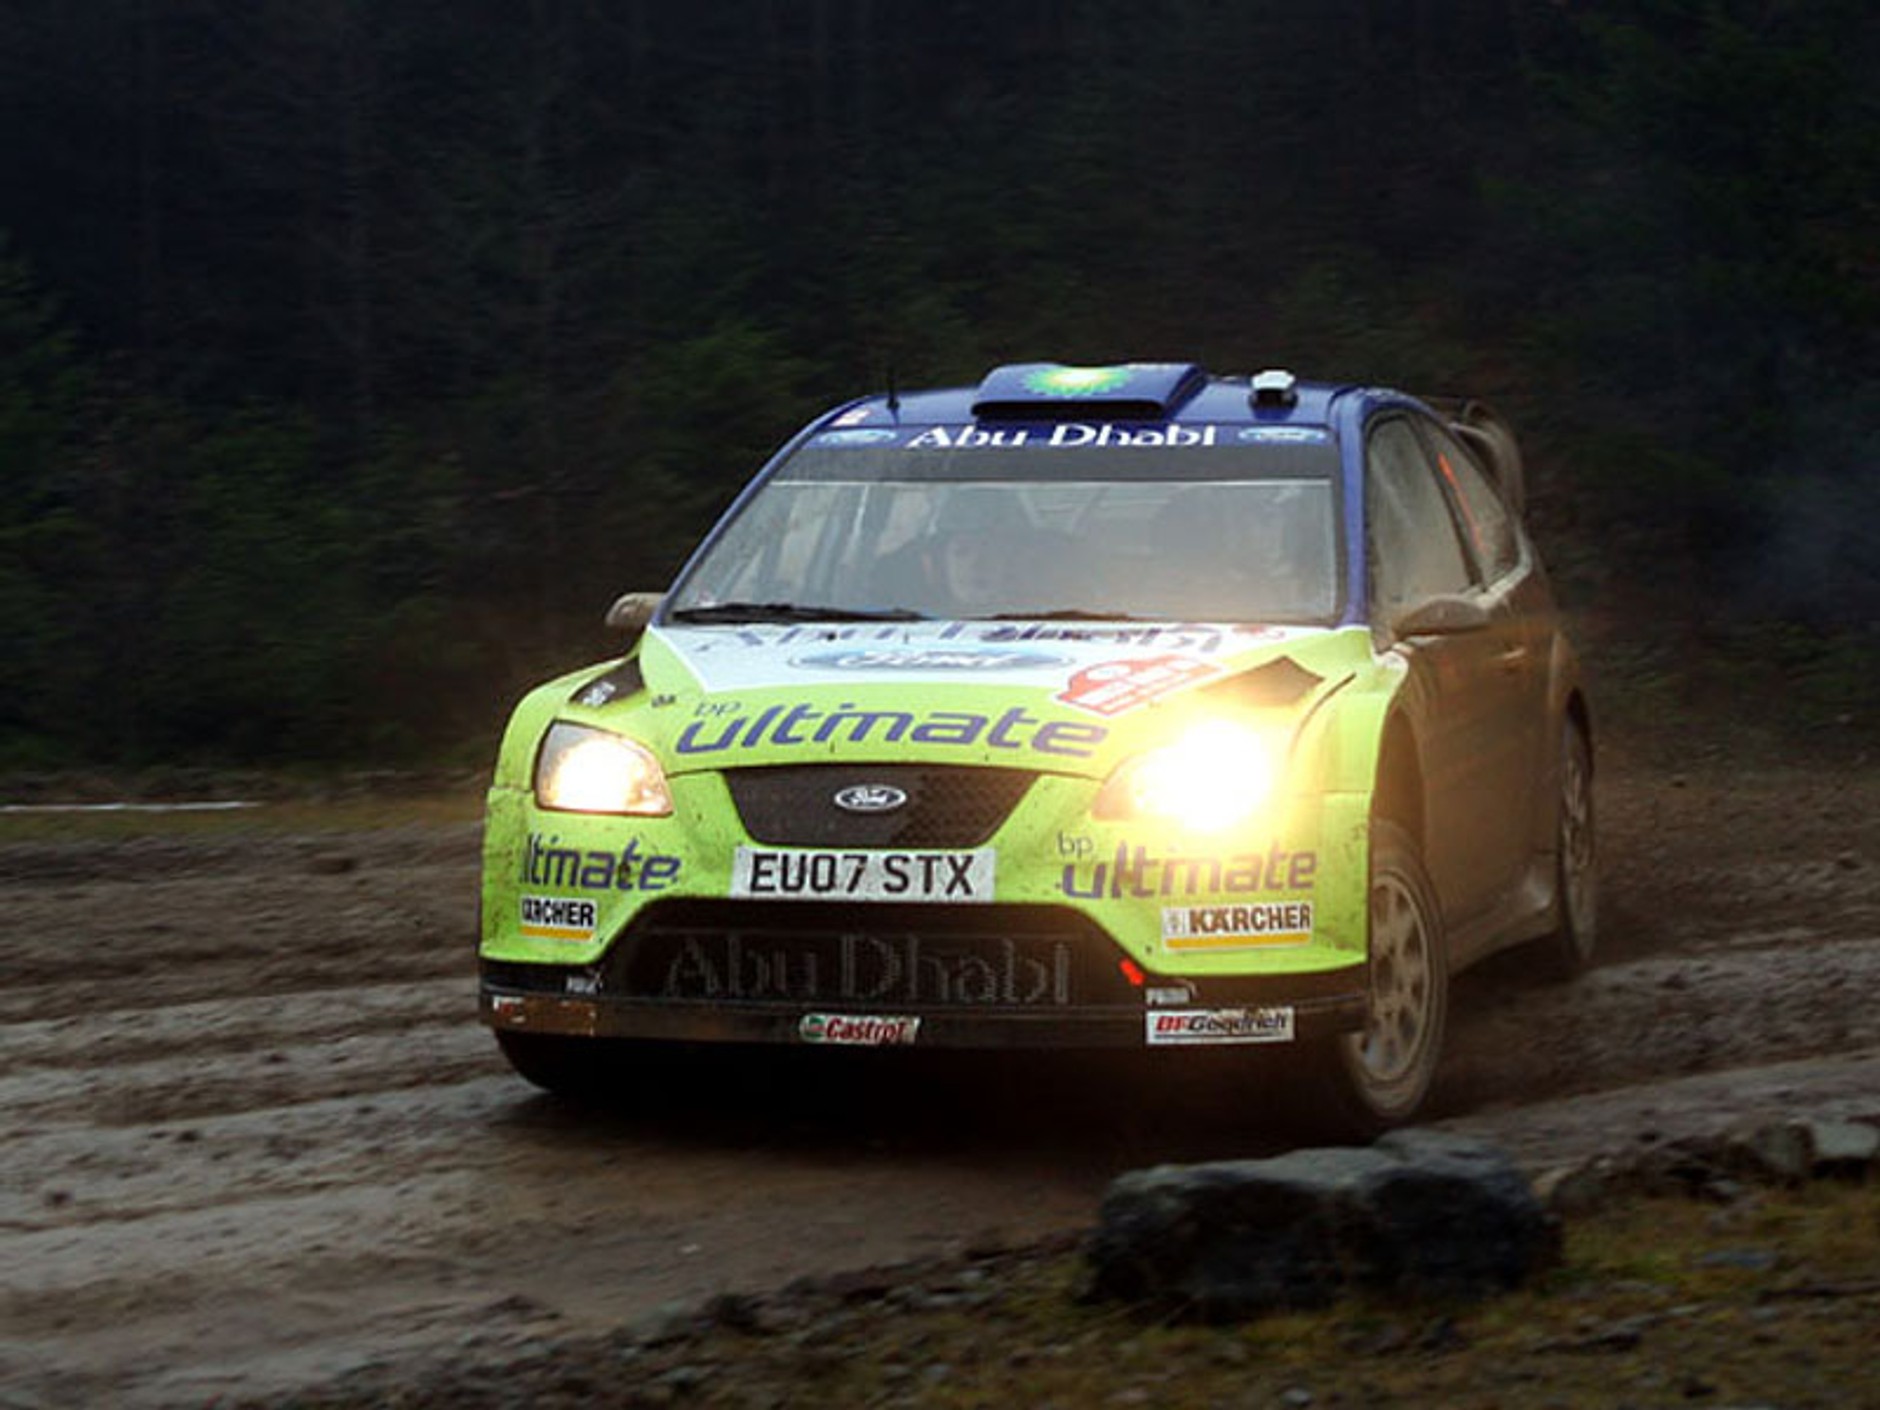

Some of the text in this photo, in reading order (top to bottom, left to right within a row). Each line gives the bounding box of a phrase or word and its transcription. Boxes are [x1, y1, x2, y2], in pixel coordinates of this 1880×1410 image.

[907, 425, 1029, 448] Abu
[694, 701, 742, 717] bp
[676, 703, 1108, 757] ultimate
[1058, 831, 1094, 858] bp
[751, 853, 975, 895] EU07 STX
[1062, 841, 1317, 899] ultimate
[1188, 903, 1311, 934] KÄRCHER
[666, 935, 818, 998] Abu
